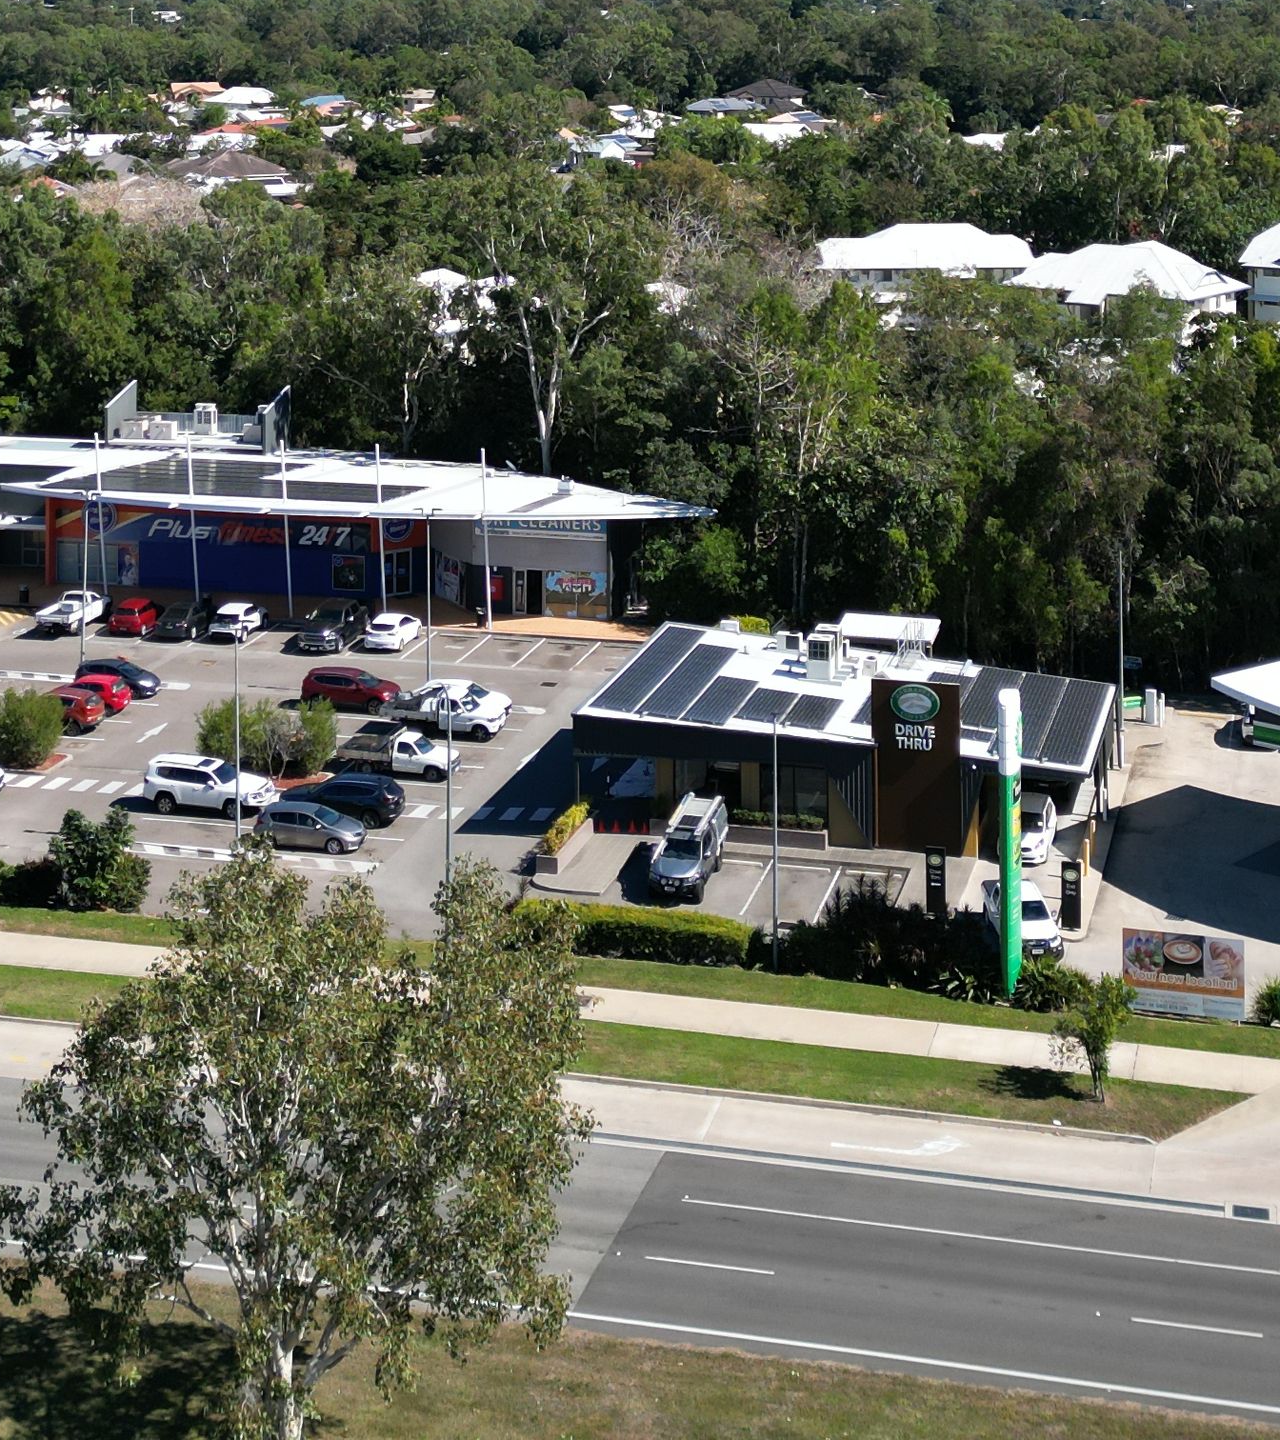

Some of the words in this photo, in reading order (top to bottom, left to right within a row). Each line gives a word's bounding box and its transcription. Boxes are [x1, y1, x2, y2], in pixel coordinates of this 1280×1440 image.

[148, 518, 212, 540] Plus
[299, 524, 352, 547] 24/7
[518, 520, 601, 531] CLEANERS
[895, 723, 936, 739] DRIVE
[895, 736, 933, 751] THRU
[1131, 970, 1158, 983] Your
[1159, 972, 1185, 985] new
[1185, 973, 1238, 991] location!
